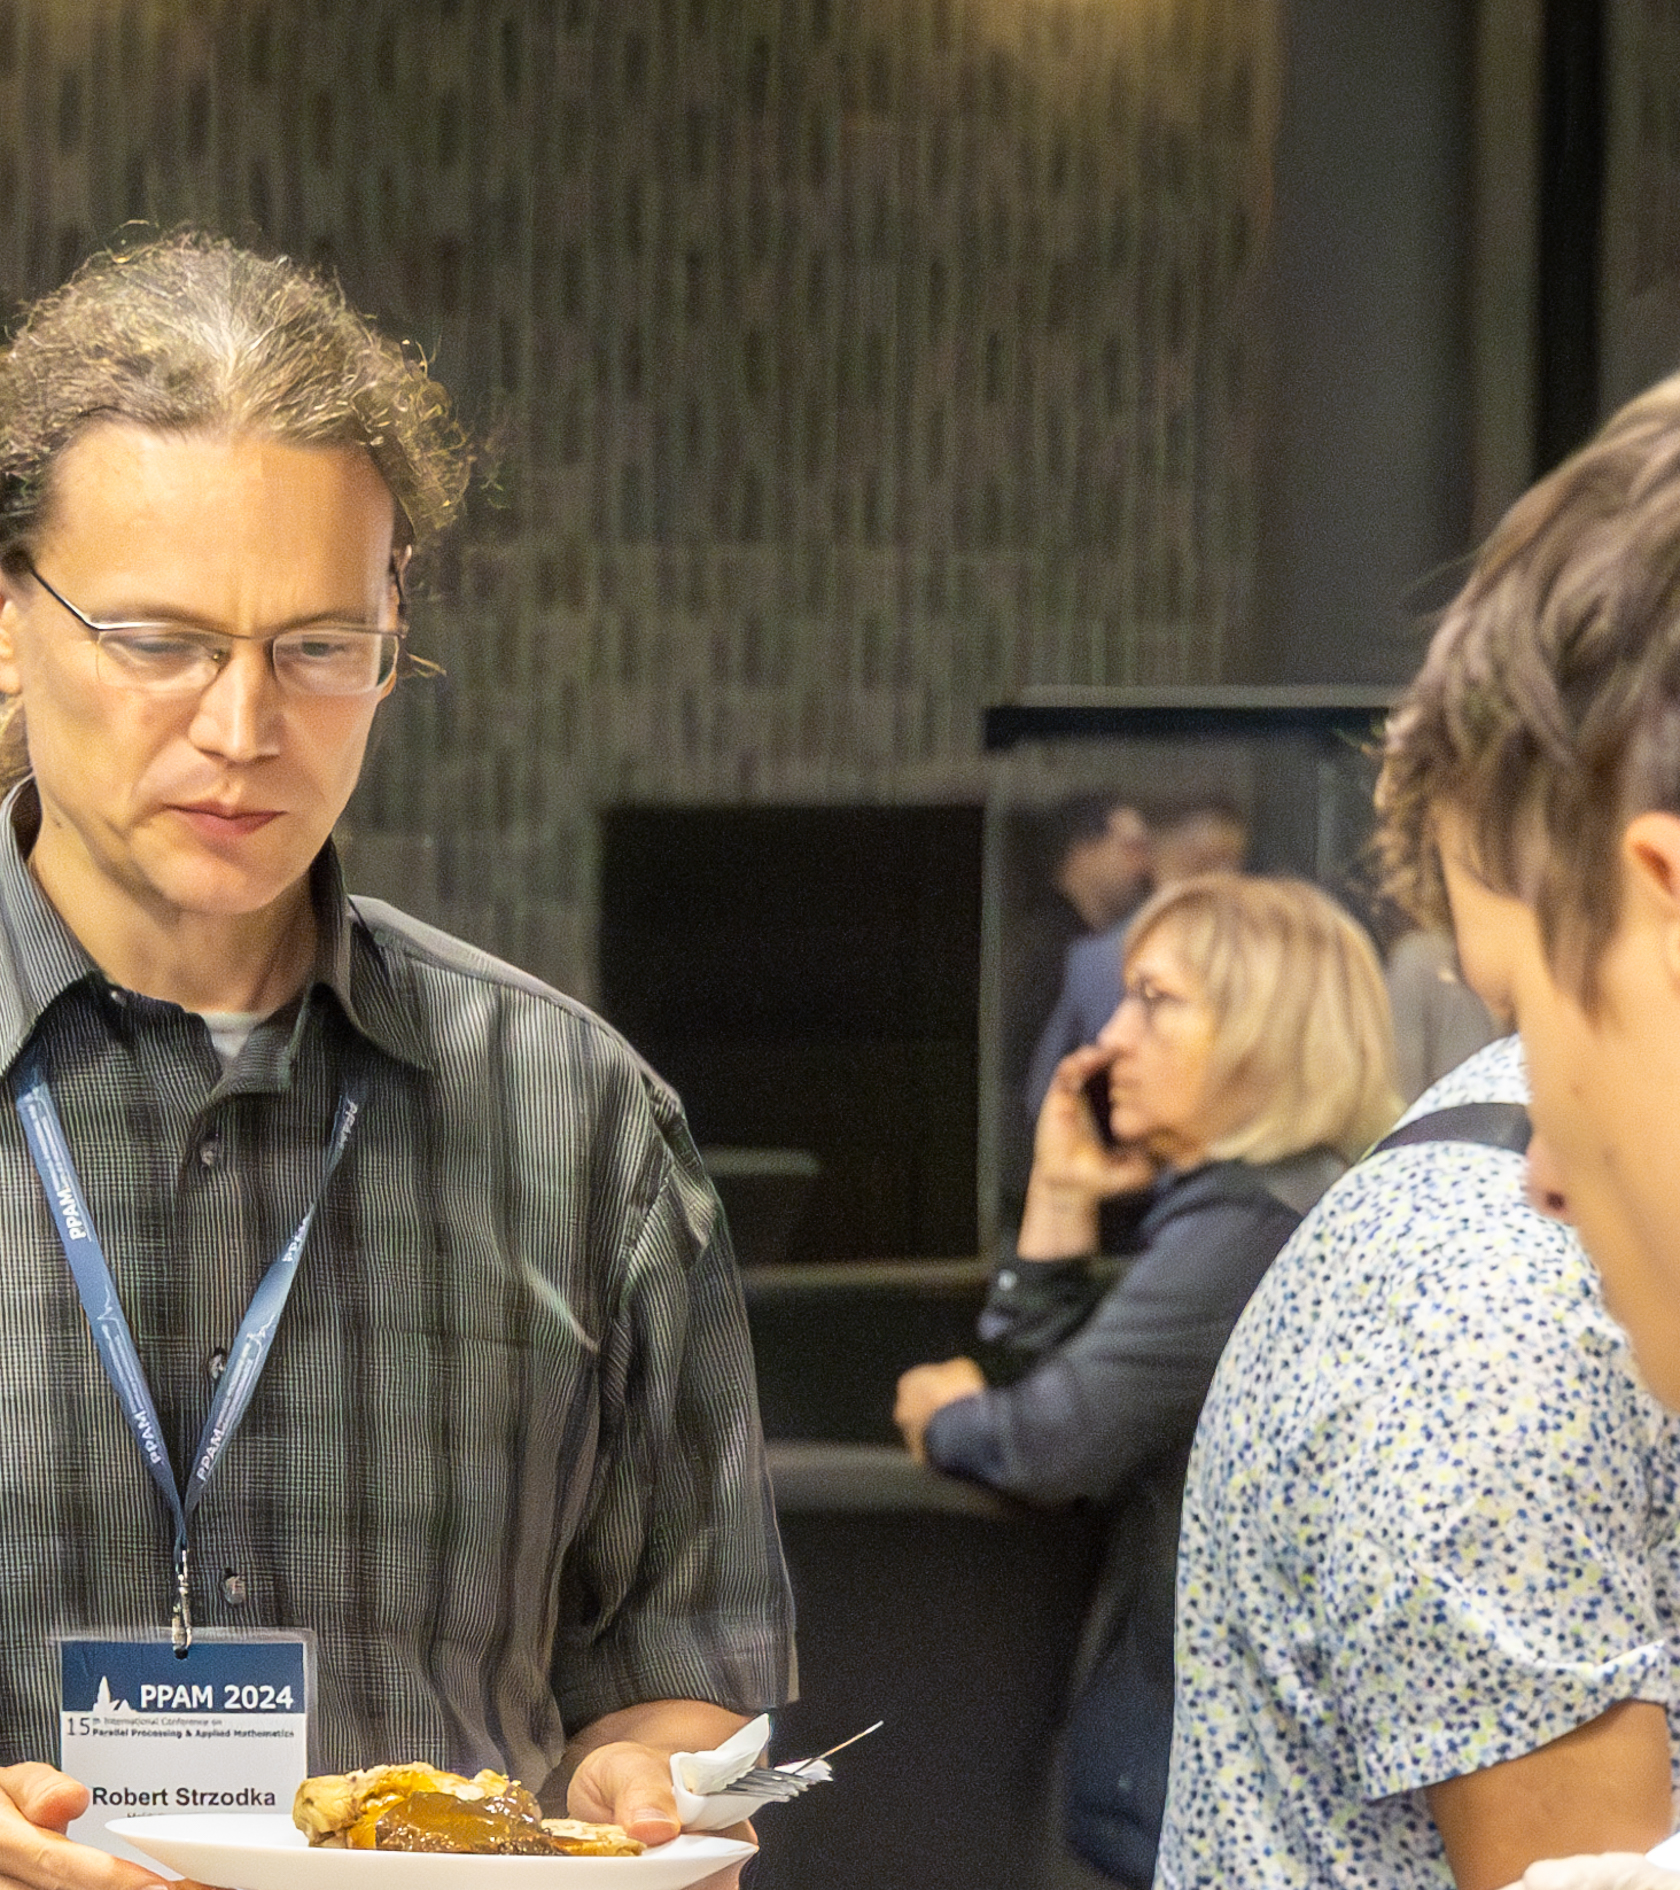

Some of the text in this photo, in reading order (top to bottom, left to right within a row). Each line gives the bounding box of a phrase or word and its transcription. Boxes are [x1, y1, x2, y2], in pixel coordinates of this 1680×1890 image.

[57, 1187, 86, 1241] PPAM
[134, 1410, 161, 1464] PPAM
[196, 1428, 224, 1481] PPAM
[140, 1684, 294, 1710] PPAM 2024
[92, 1787, 276, 1806] Robert Strzodka
